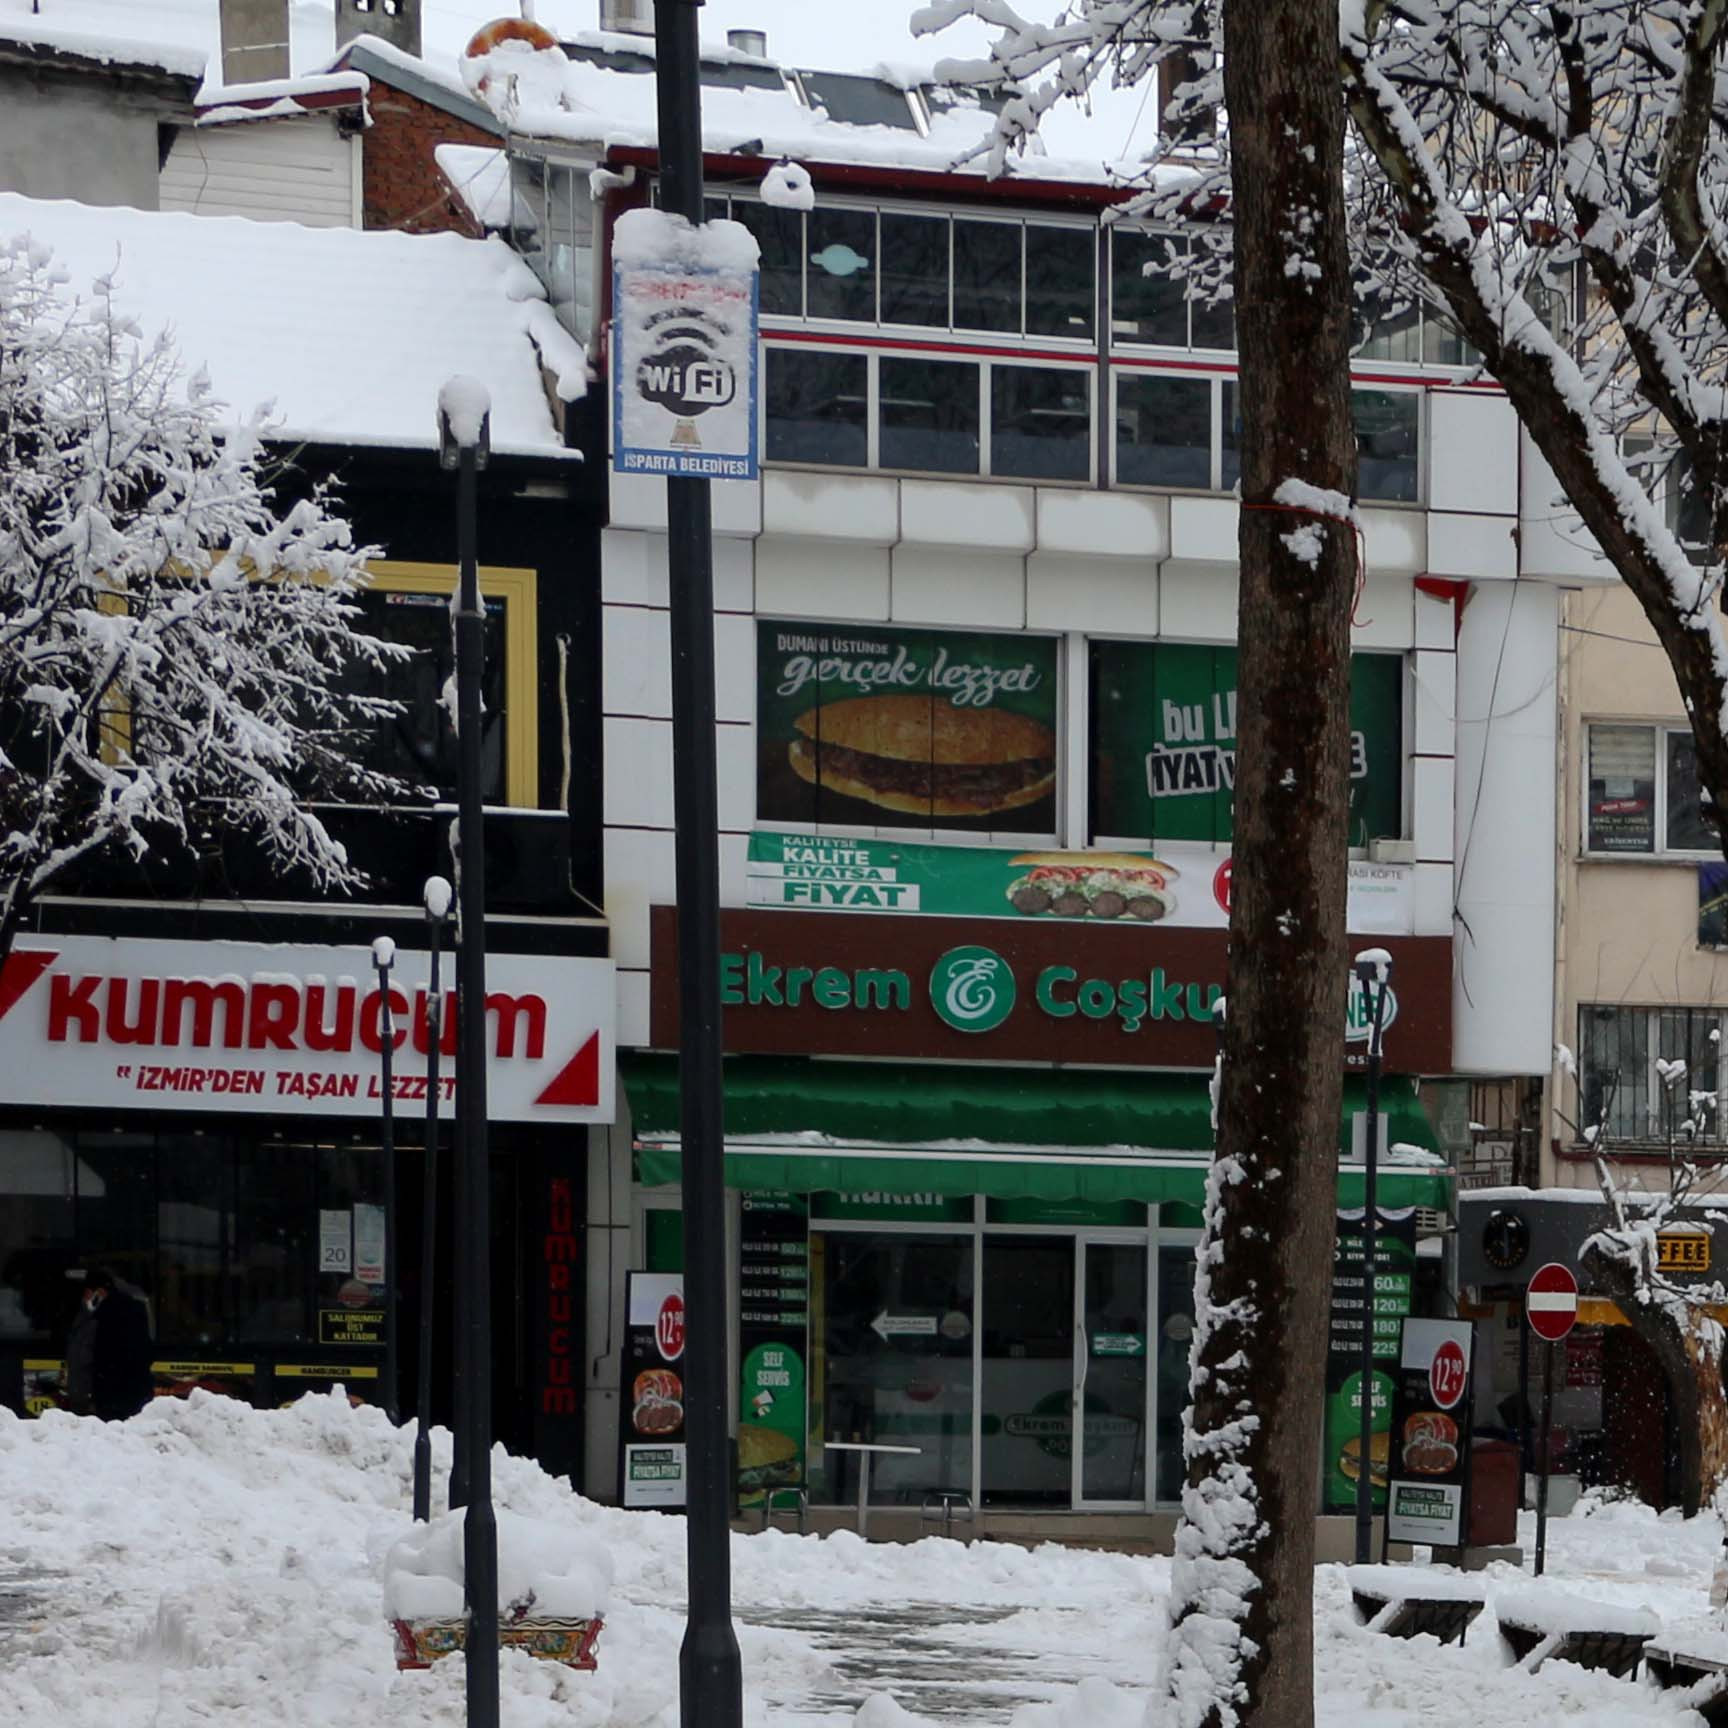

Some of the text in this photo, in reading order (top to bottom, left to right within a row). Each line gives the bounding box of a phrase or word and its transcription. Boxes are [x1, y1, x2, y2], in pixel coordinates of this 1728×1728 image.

[680, 455, 749, 476] BELEDİYESİ
[777, 645, 1042, 706] gerçek lezzet
[783, 847, 870, 866] KALİTE
[782, 865, 883, 881] FİYATSA
[783, 881, 906, 907] FİYAT
[1035, 965, 1224, 1033] Coşku
[276, 1070, 358, 1101] TAŞAN
[324, 1247, 346, 1263] 20
[661, 1311, 674, 1345] 12
[1435, 1357, 1451, 1393] 12
